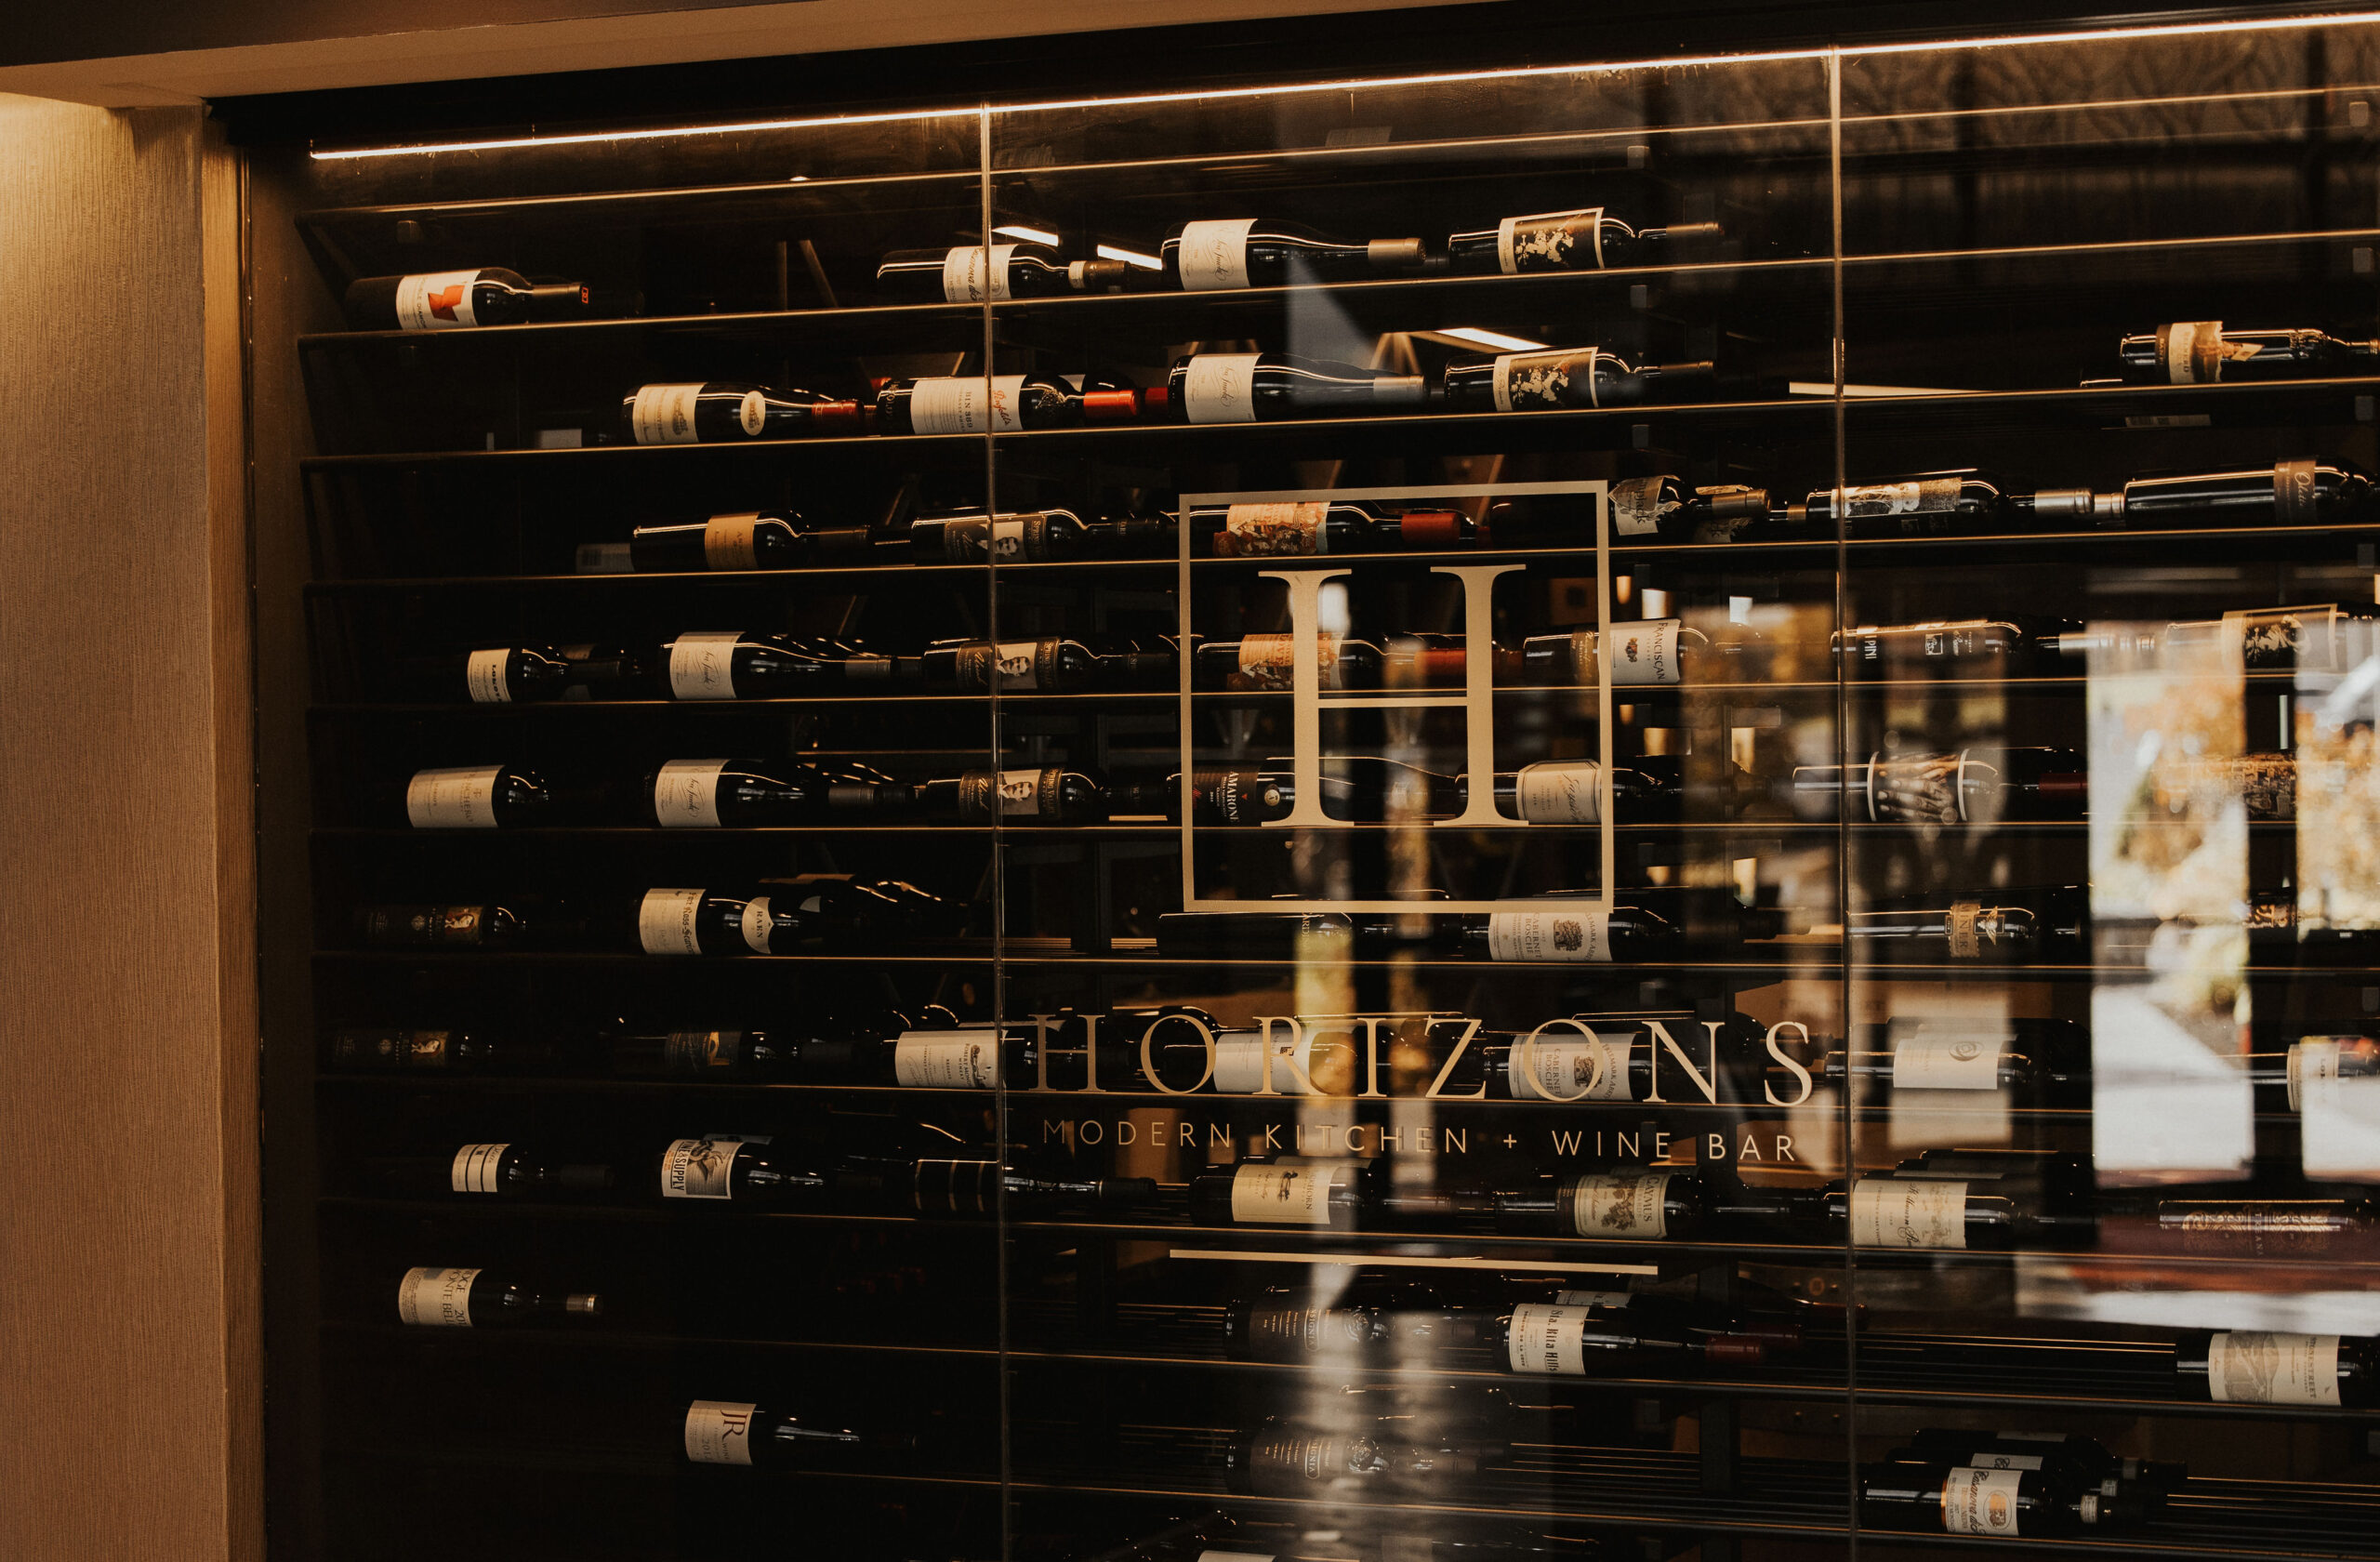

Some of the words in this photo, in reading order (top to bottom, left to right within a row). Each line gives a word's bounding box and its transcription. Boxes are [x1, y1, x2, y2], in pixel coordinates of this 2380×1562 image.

[964, 392, 972, 410] BIN
[964, 412, 973, 428] 389
[993, 390, 1012, 426] Penfolds
[1654, 622, 1670, 681] FRANCISCAN
[1863, 641, 1878, 659] PINI
[1226, 771, 1240, 823] AMARONE
[756, 910, 764, 938] RAEN
[1958, 904, 1972, 948] MINER
[1027, 1013, 1813, 1106] HORIZONS
[1551, 1048, 1562, 1095] CABERNET
[1043, 1119, 1231, 1149] MODERN
[1265, 1123, 1466, 1154] KITCHEN
[1552, 1130, 1672, 1159] WINE
[1709, 1133, 1795, 1162] BAR
[1642, 1176, 1660, 1222] CAYMUS
[1545, 1329, 1559, 1349] Rita
[1544, 1352, 1559, 1372] Hills
[720, 1410, 748, 1441] JR
[1969, 1471, 1990, 1514] Casanova
